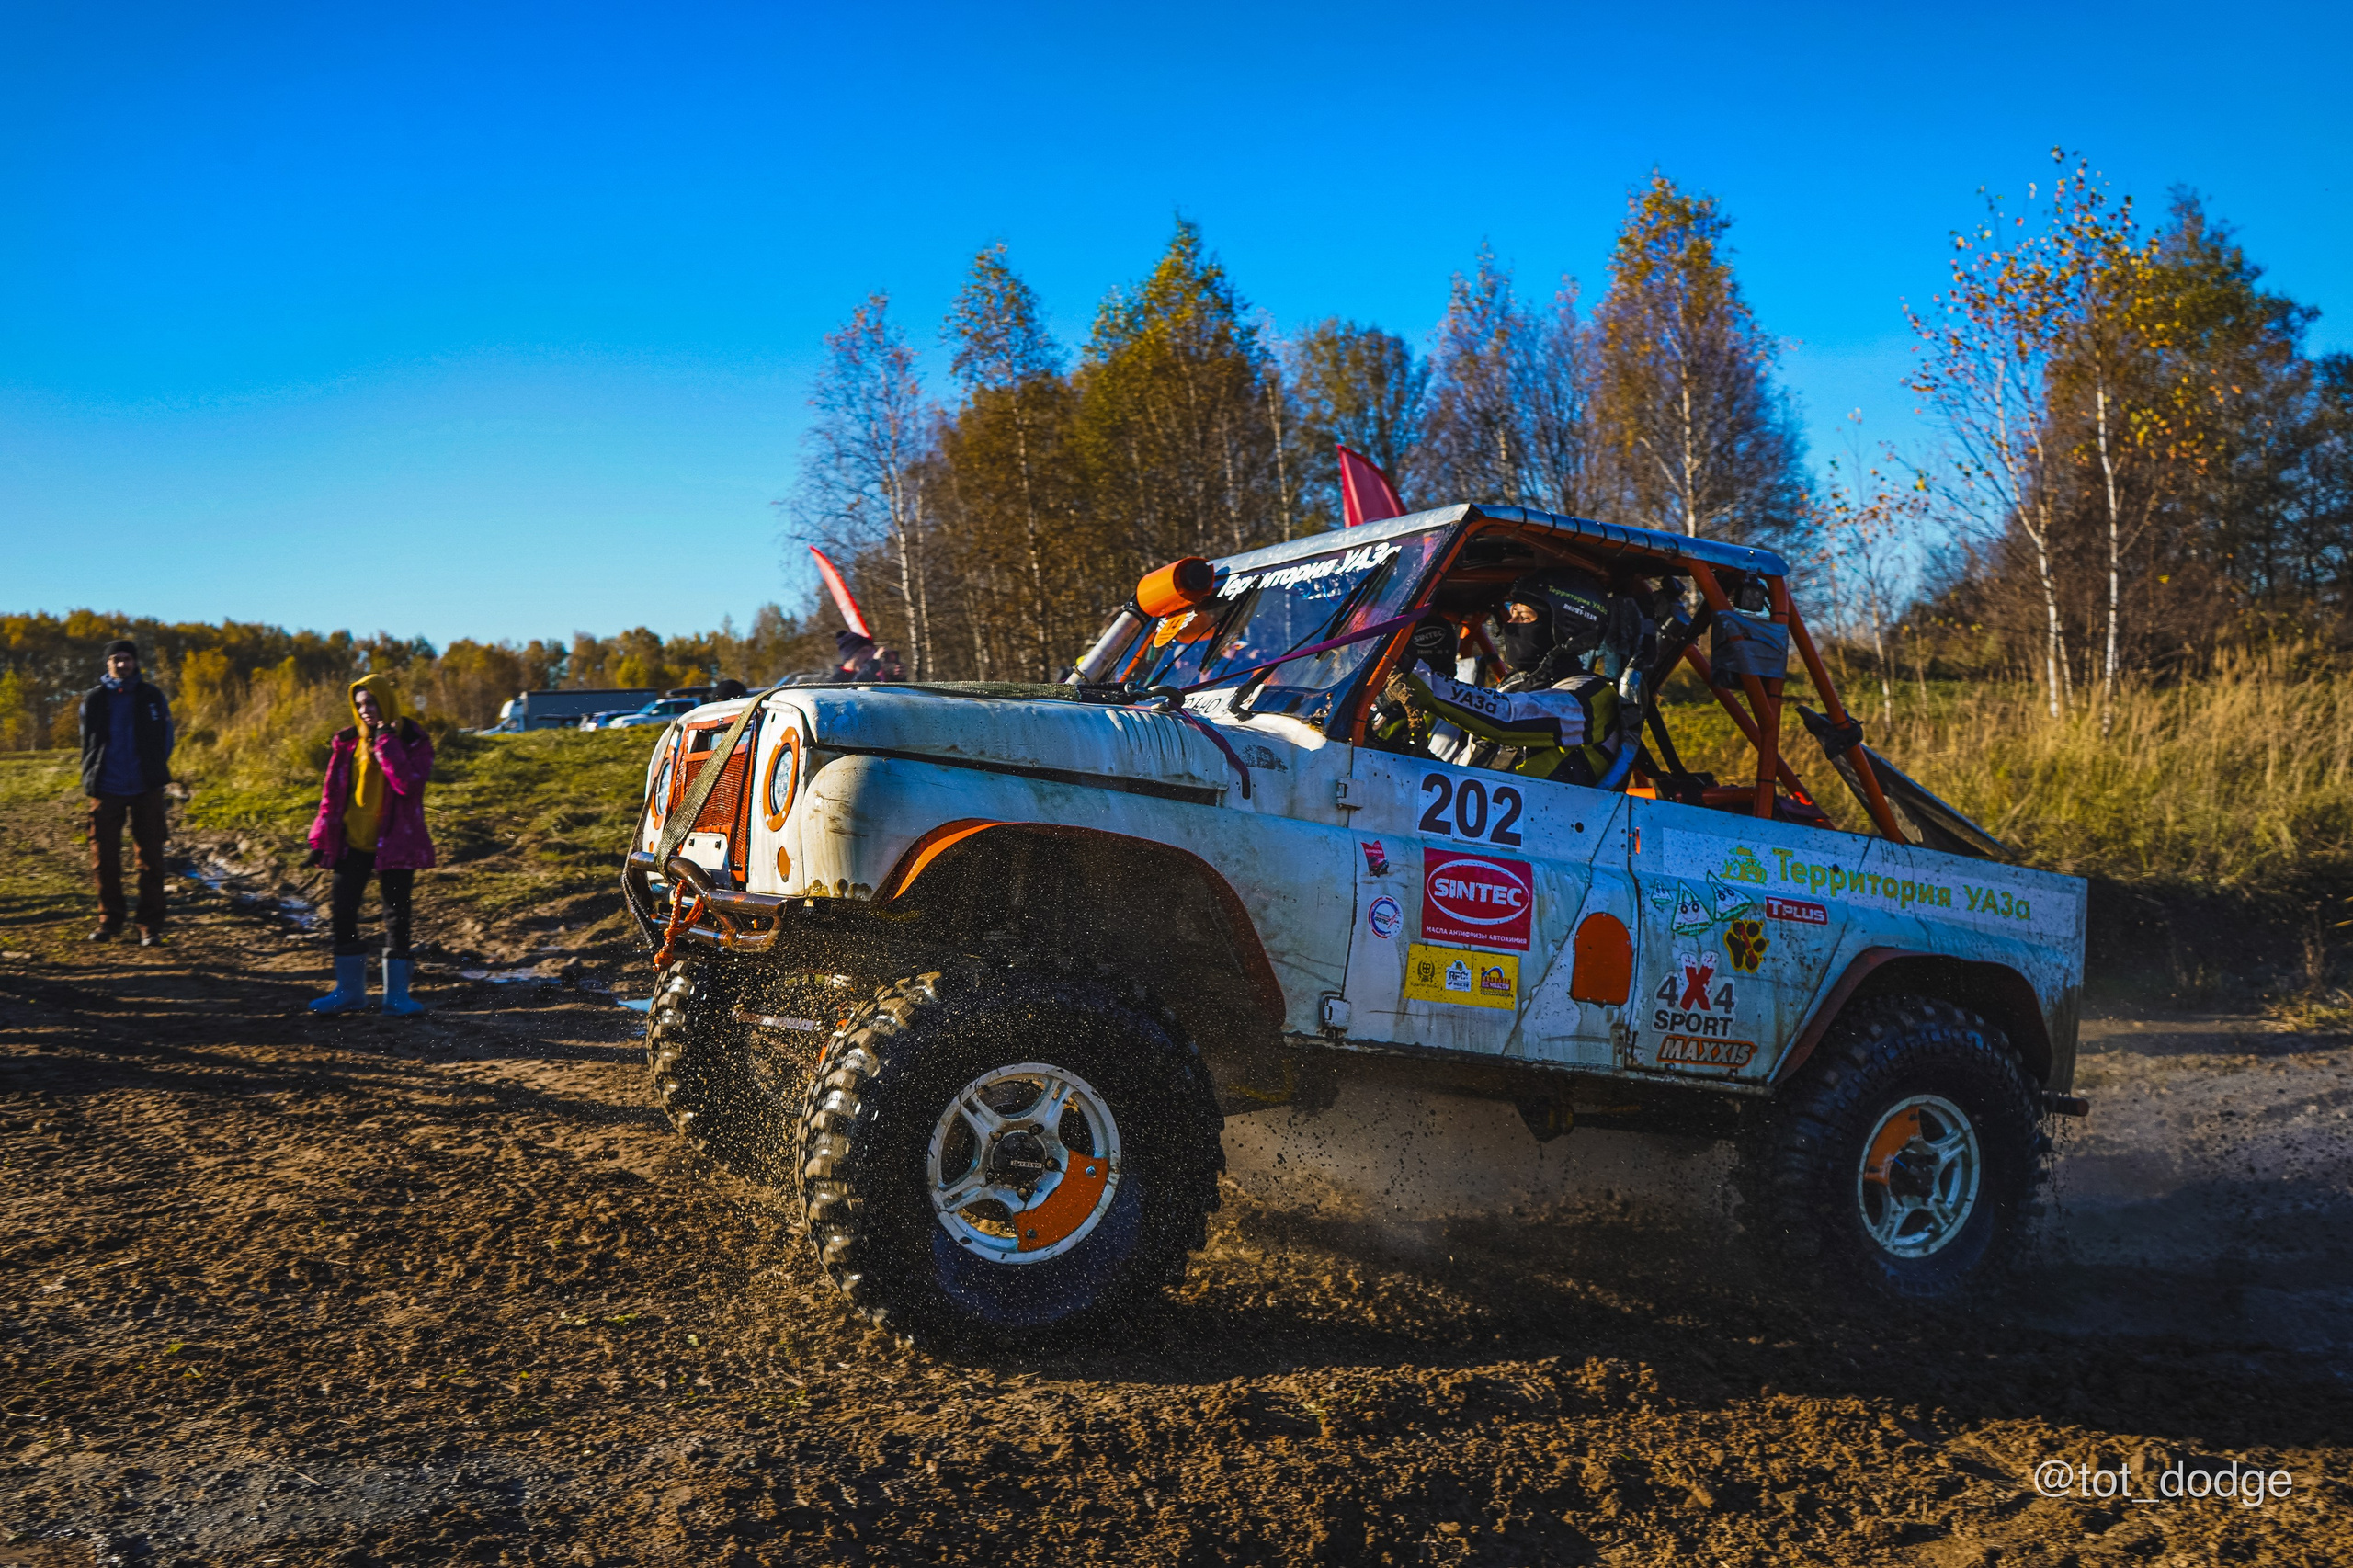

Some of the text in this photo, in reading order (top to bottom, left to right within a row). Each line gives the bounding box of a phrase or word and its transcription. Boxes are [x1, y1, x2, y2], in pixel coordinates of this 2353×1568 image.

[1217, 559, 1338, 600] Територия
[1450, 686, 1497, 714] УАЗа
[1418, 773, 1523, 846] 202
[1434, 878, 1522, 907] SINTEC
[1772, 847, 2030, 920] Территория УАЗа
[1768, 899, 1825, 922] TPLUS
[1426, 926, 1528, 945] МАСЛА АНТИФРИЗЫ АВТОХИМИЯ
[1654, 1009, 1733, 1037] SPORT
[1661, 1039, 1751, 1065] MAXXIS
